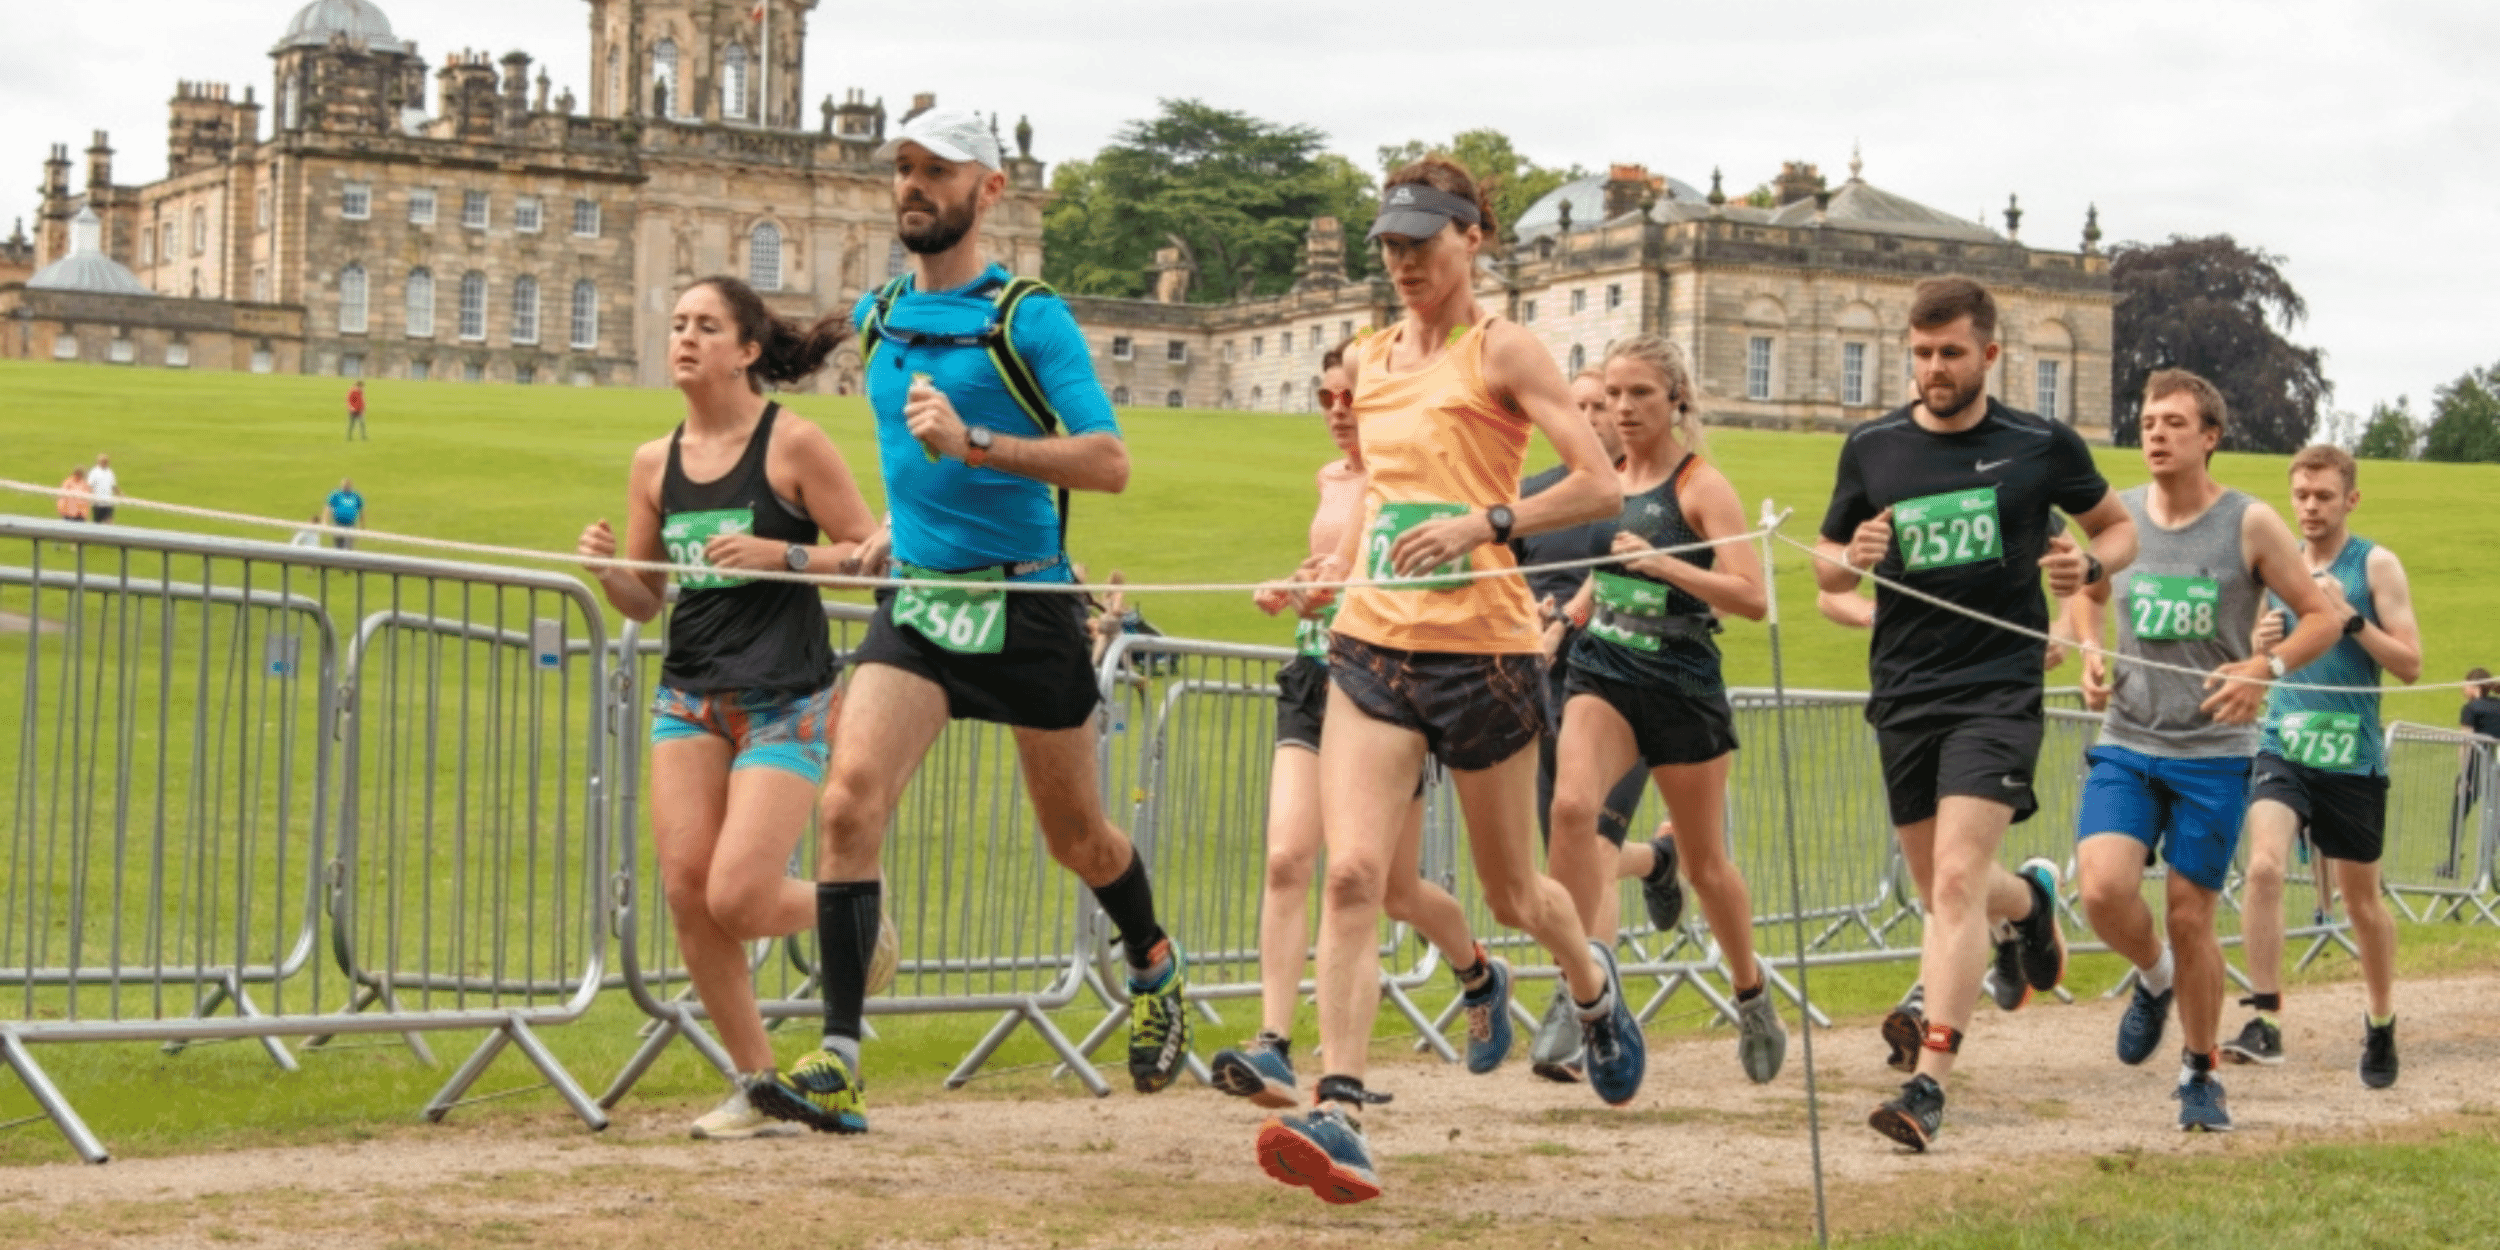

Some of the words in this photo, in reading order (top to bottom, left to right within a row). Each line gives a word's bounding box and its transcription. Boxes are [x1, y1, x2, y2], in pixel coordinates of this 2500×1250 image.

[1903, 514, 1995, 565] 2529
[897, 600, 1001, 647] 2567
[2134, 598, 2212, 635] 2788
[2283, 730, 2355, 763] 2752
